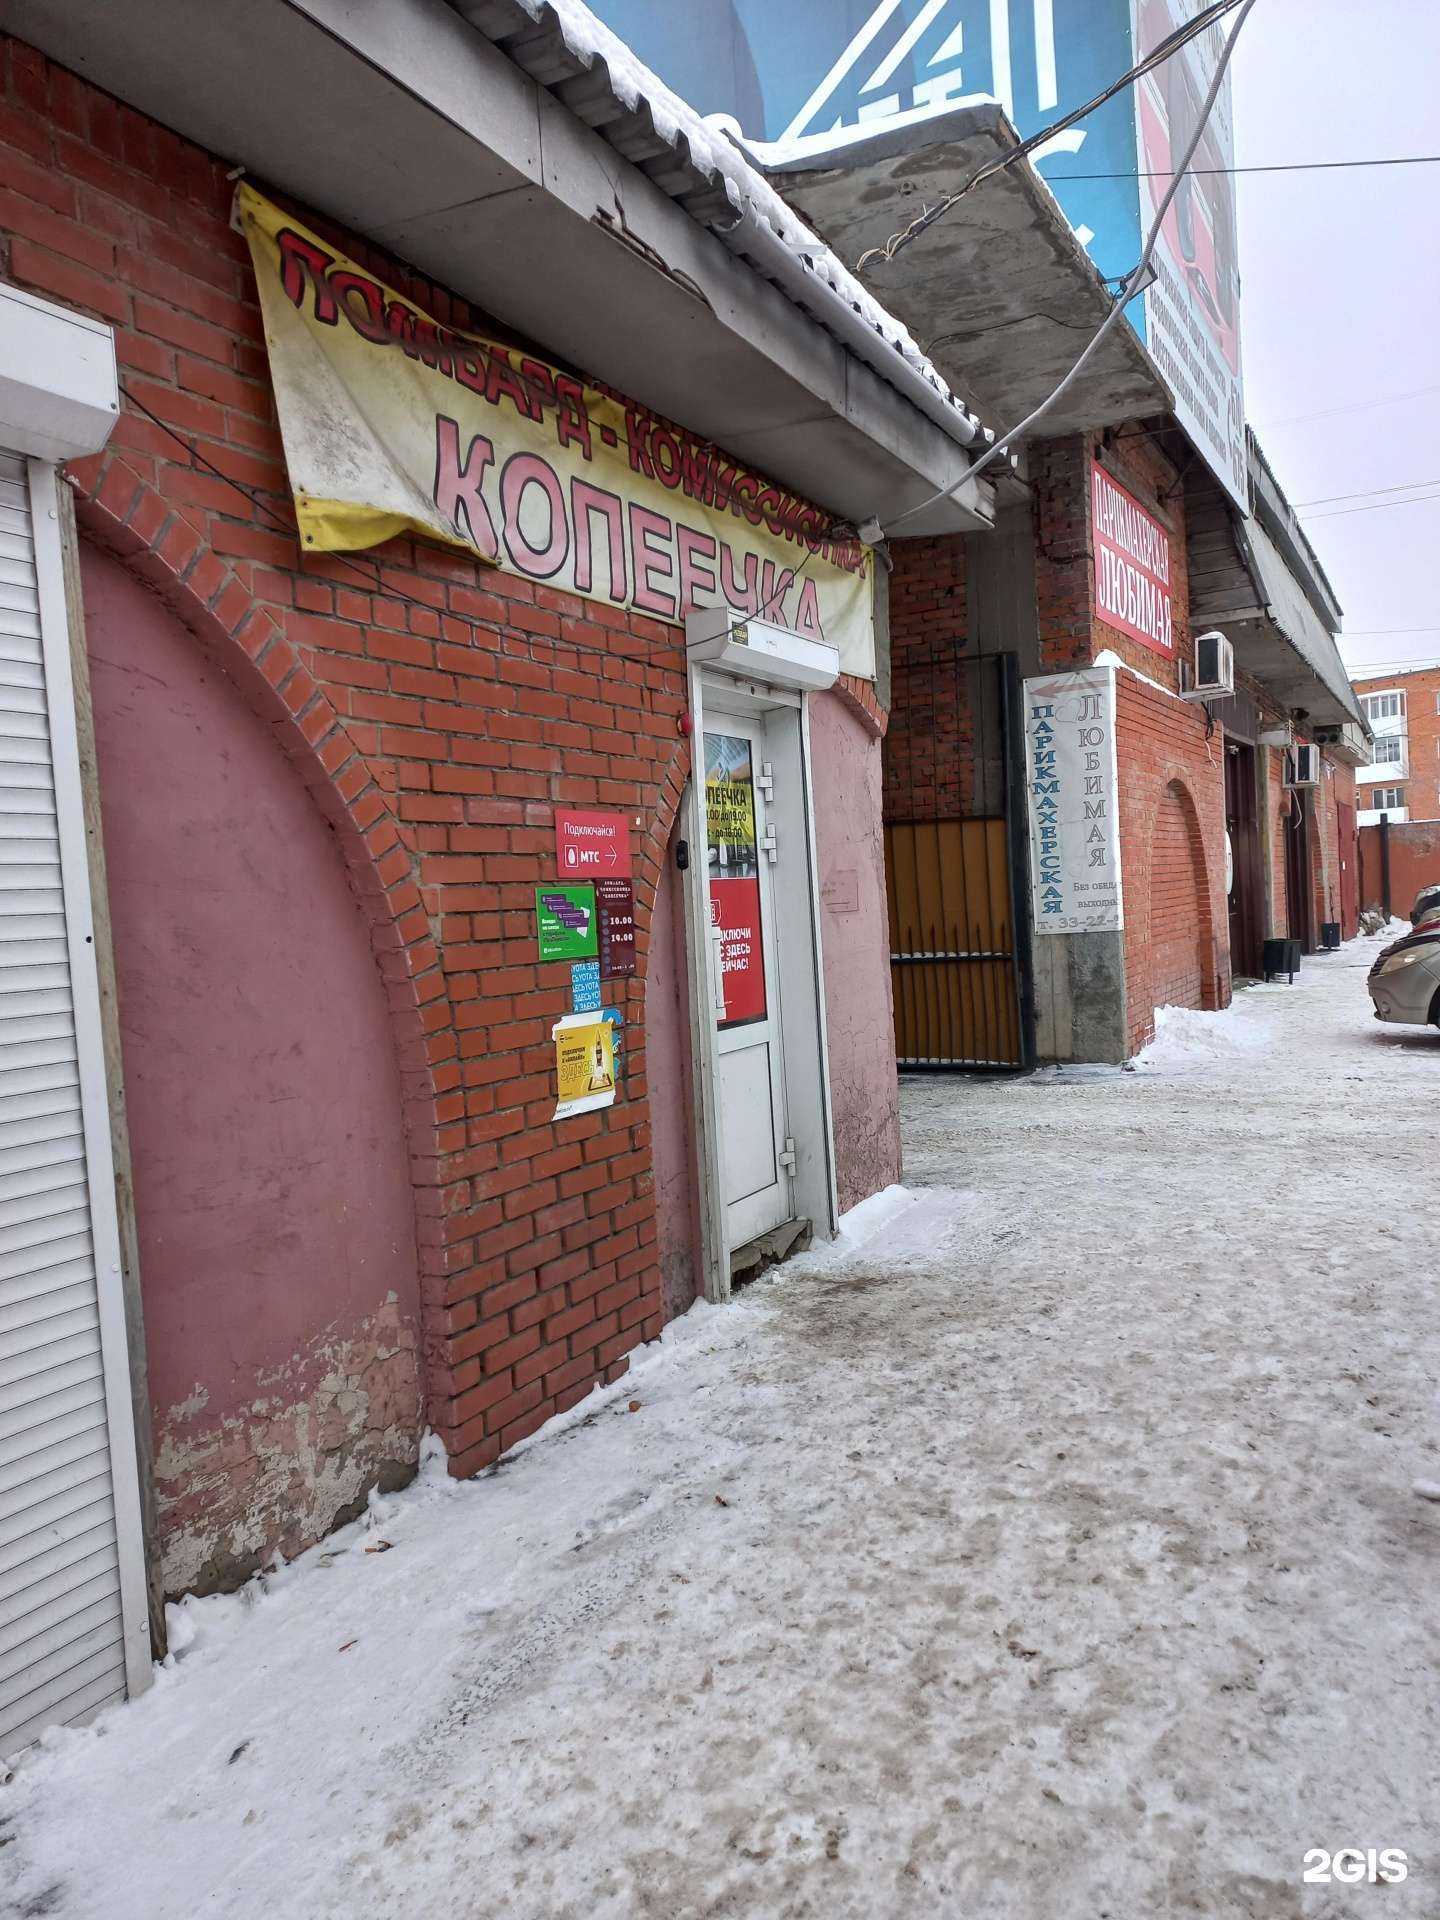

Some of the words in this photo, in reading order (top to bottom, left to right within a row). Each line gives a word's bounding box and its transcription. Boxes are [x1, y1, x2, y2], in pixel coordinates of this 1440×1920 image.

[433, 413, 825, 642] КОПЕЕЧКА
[1094, 470, 1169, 587] ПАРИКМАХЕРСКАЯ
[1099, 543, 1172, 650] ЛЮБИМАЯ
[1077, 693, 1106, 868] ЛЮБИМАЯ
[705, 785, 747, 806] ПЕЕЧКА
[1031, 704, 1063, 914] ПАРИКМАХЕРСКАЯ
[564, 822, 616, 837] Подключайся!
[580, 851, 600, 863] МТС
[610, 916, 632, 925] 10.00
[726, 943, 751, 957] ЗДЕСЬ
[720, 958, 749, 973] ЕЙЧАС!
